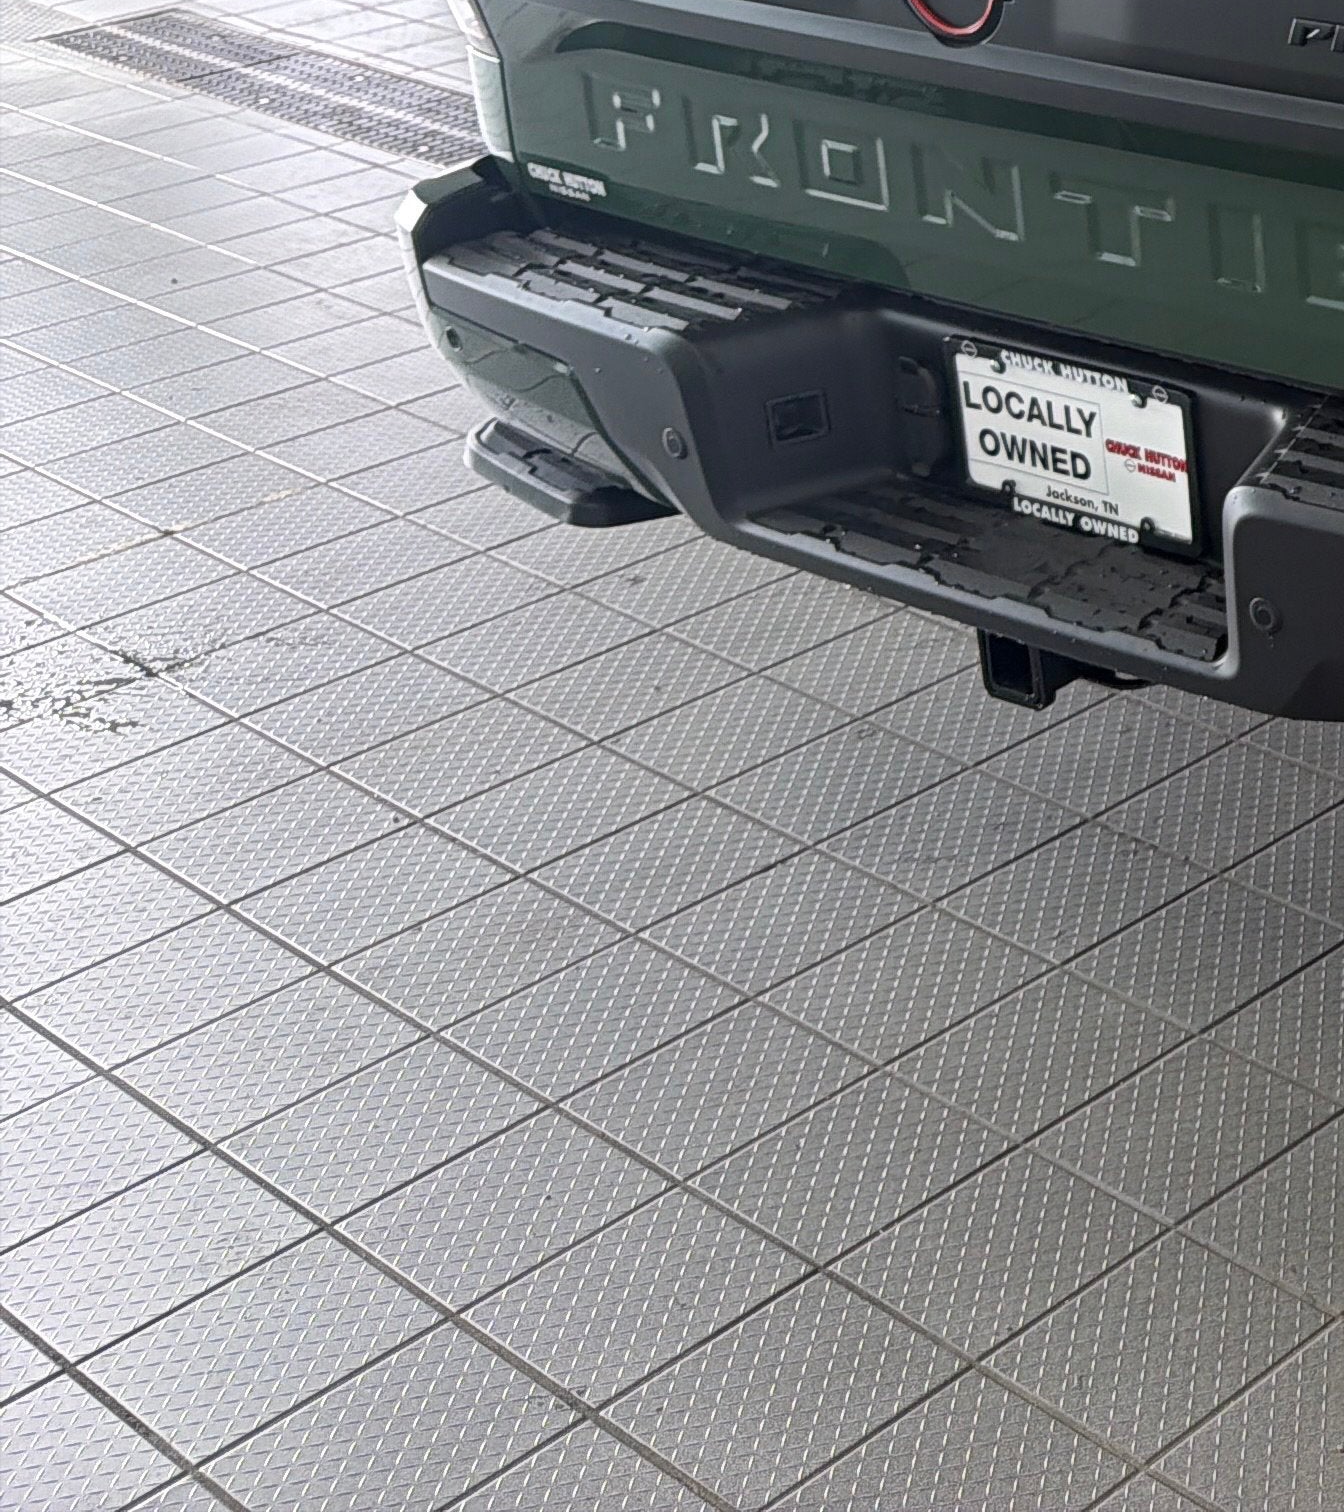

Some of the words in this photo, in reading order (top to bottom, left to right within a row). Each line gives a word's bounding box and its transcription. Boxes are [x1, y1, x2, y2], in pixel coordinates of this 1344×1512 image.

[1000, 348, 1055, 377] CHUCK
[1060, 363, 1128, 393] HUTTON
[962, 380, 1097, 438] LOCALLY
[979, 428, 1091, 481] OWNED
[1105, 438, 1142, 460] CHUCK
[1144, 448, 1188, 473] HUTTON
[1137, 463, 1176, 482] NISSAN
[1013, 496, 1074, 527] LOCALLY
[1080, 517, 1139, 544] OWNED
[1046, 485, 1099, 513] Jackson,
[1102, 500, 1120, 516] TN
